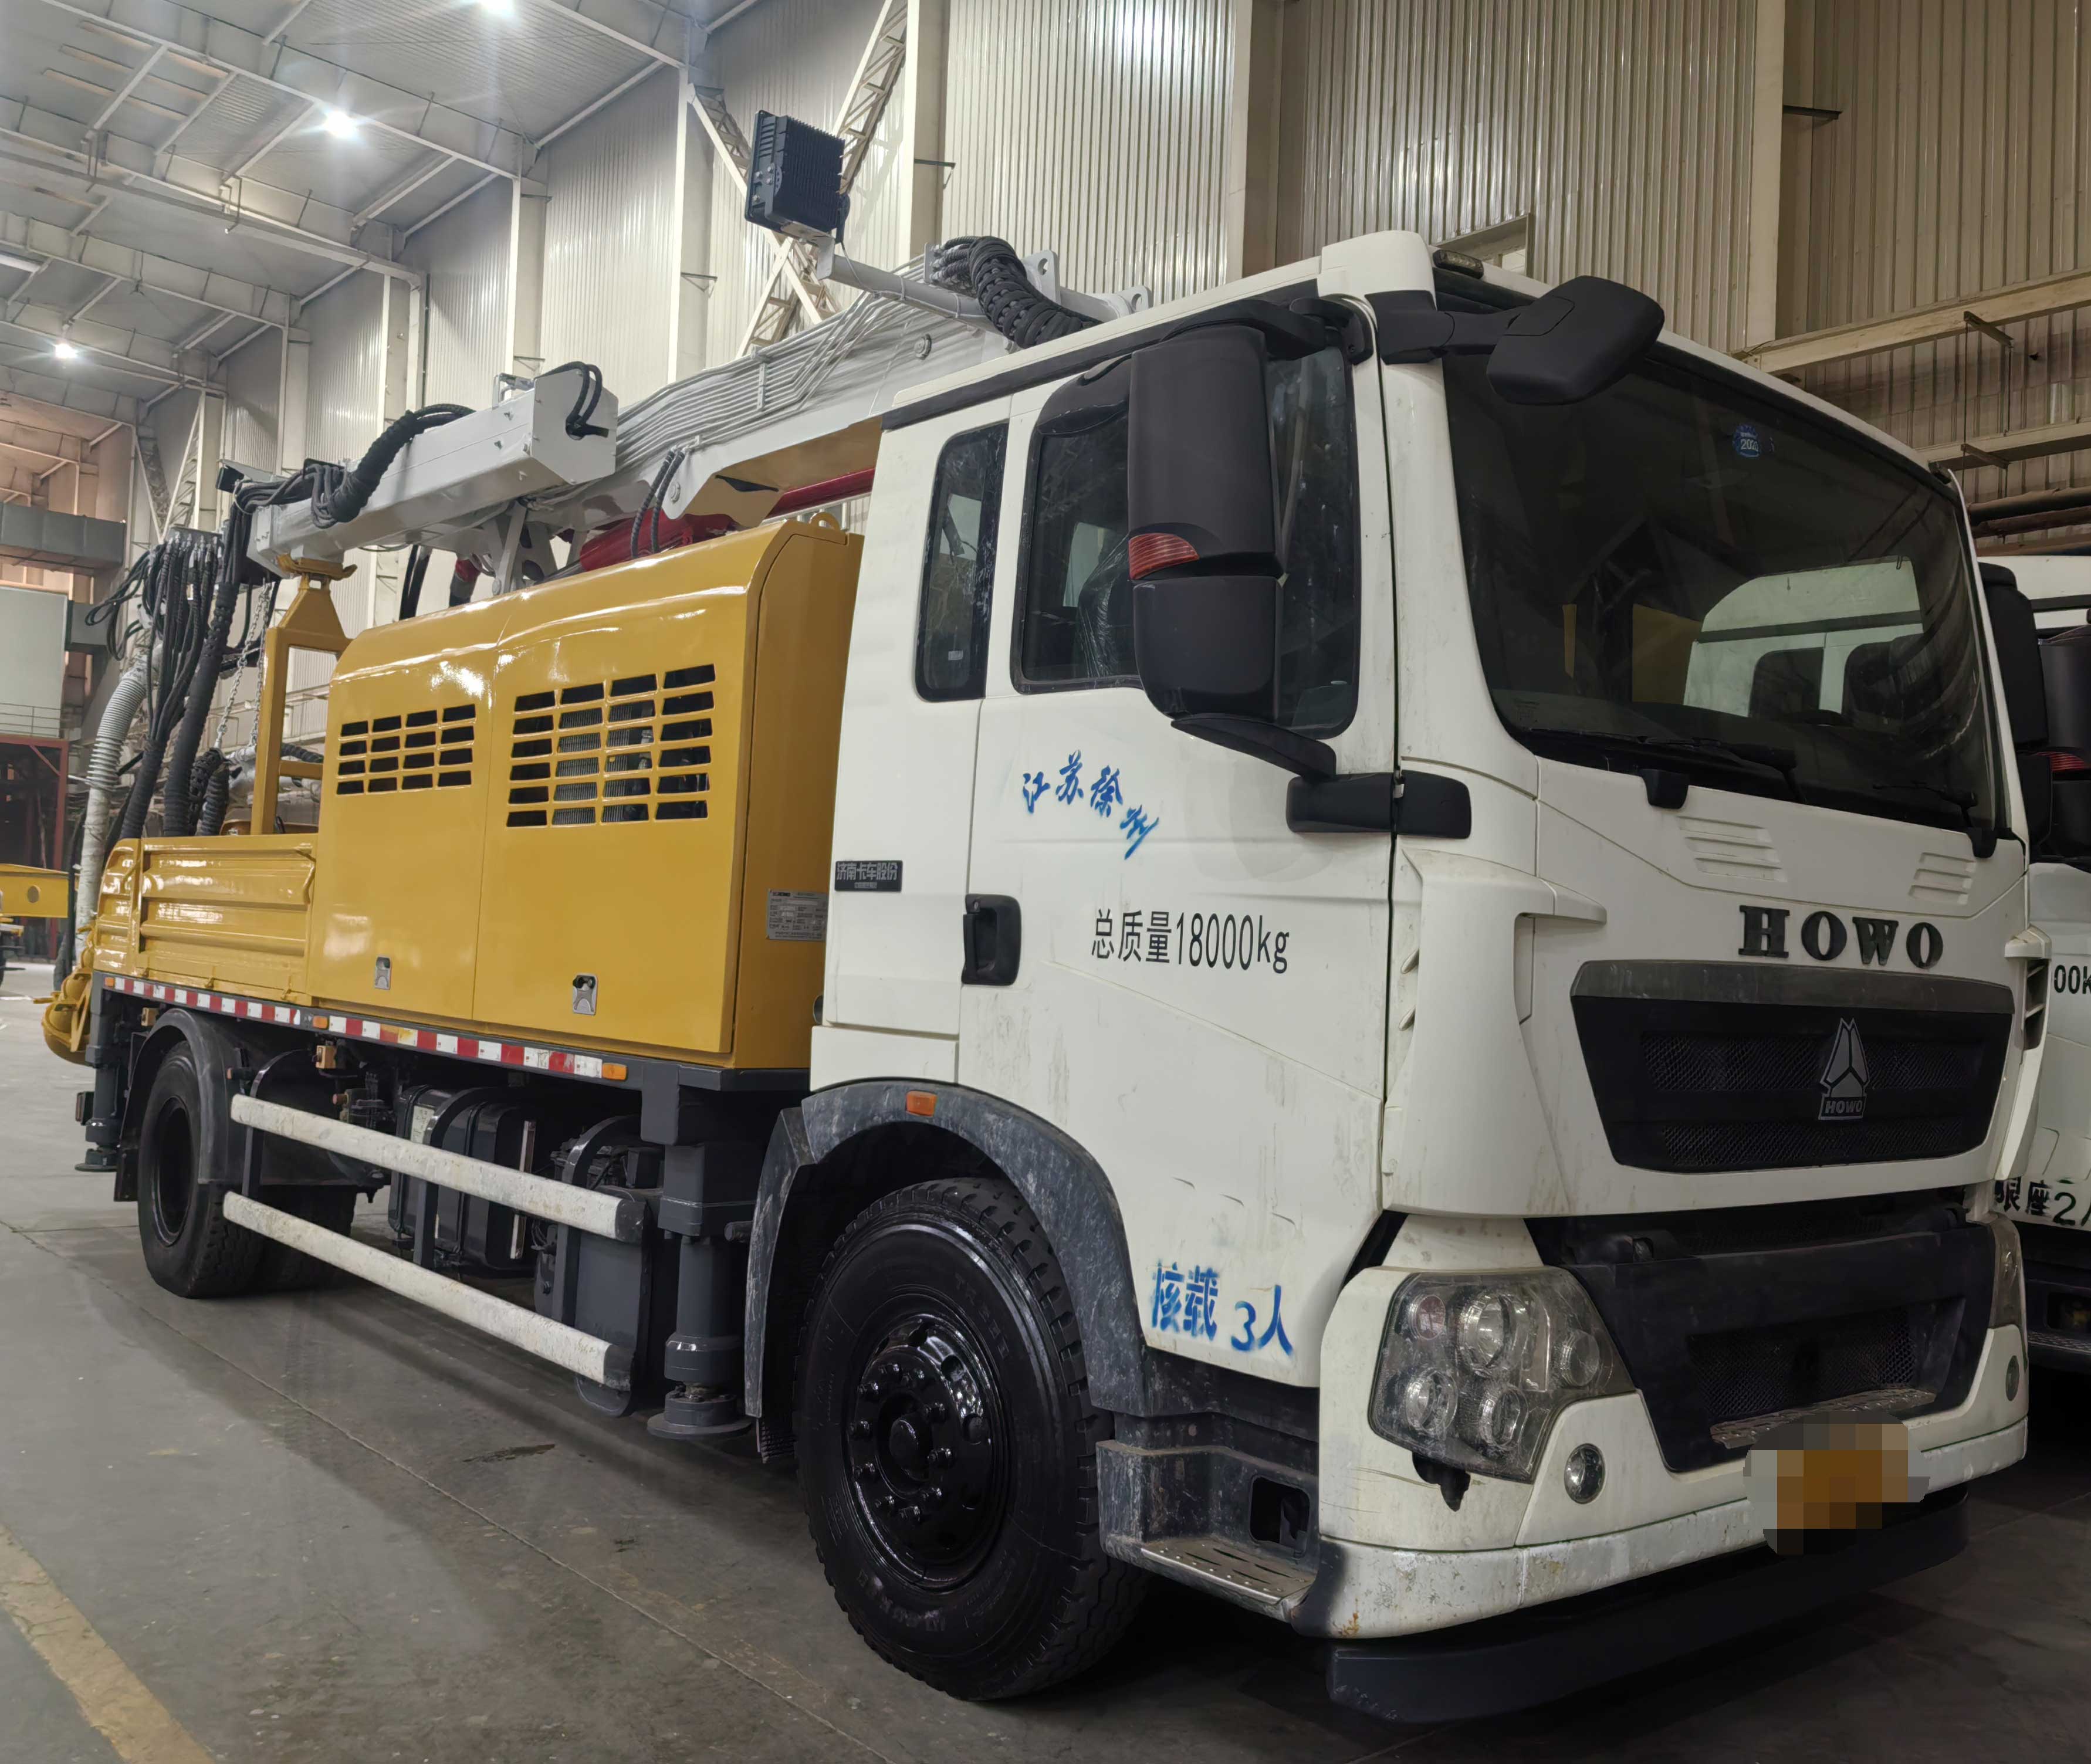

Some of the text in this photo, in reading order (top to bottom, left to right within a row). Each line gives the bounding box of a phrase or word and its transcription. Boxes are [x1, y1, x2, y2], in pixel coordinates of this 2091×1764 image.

[1023, 750, 1159, 861] 江苏徐州
[836, 862, 898, 881] 济南卡车股份
[1091, 908, 1290, 974] 总质量18000kg
[1738, 905, 1944, 970] HOWO
[1825, 1099, 1863, 1114] HOWO
